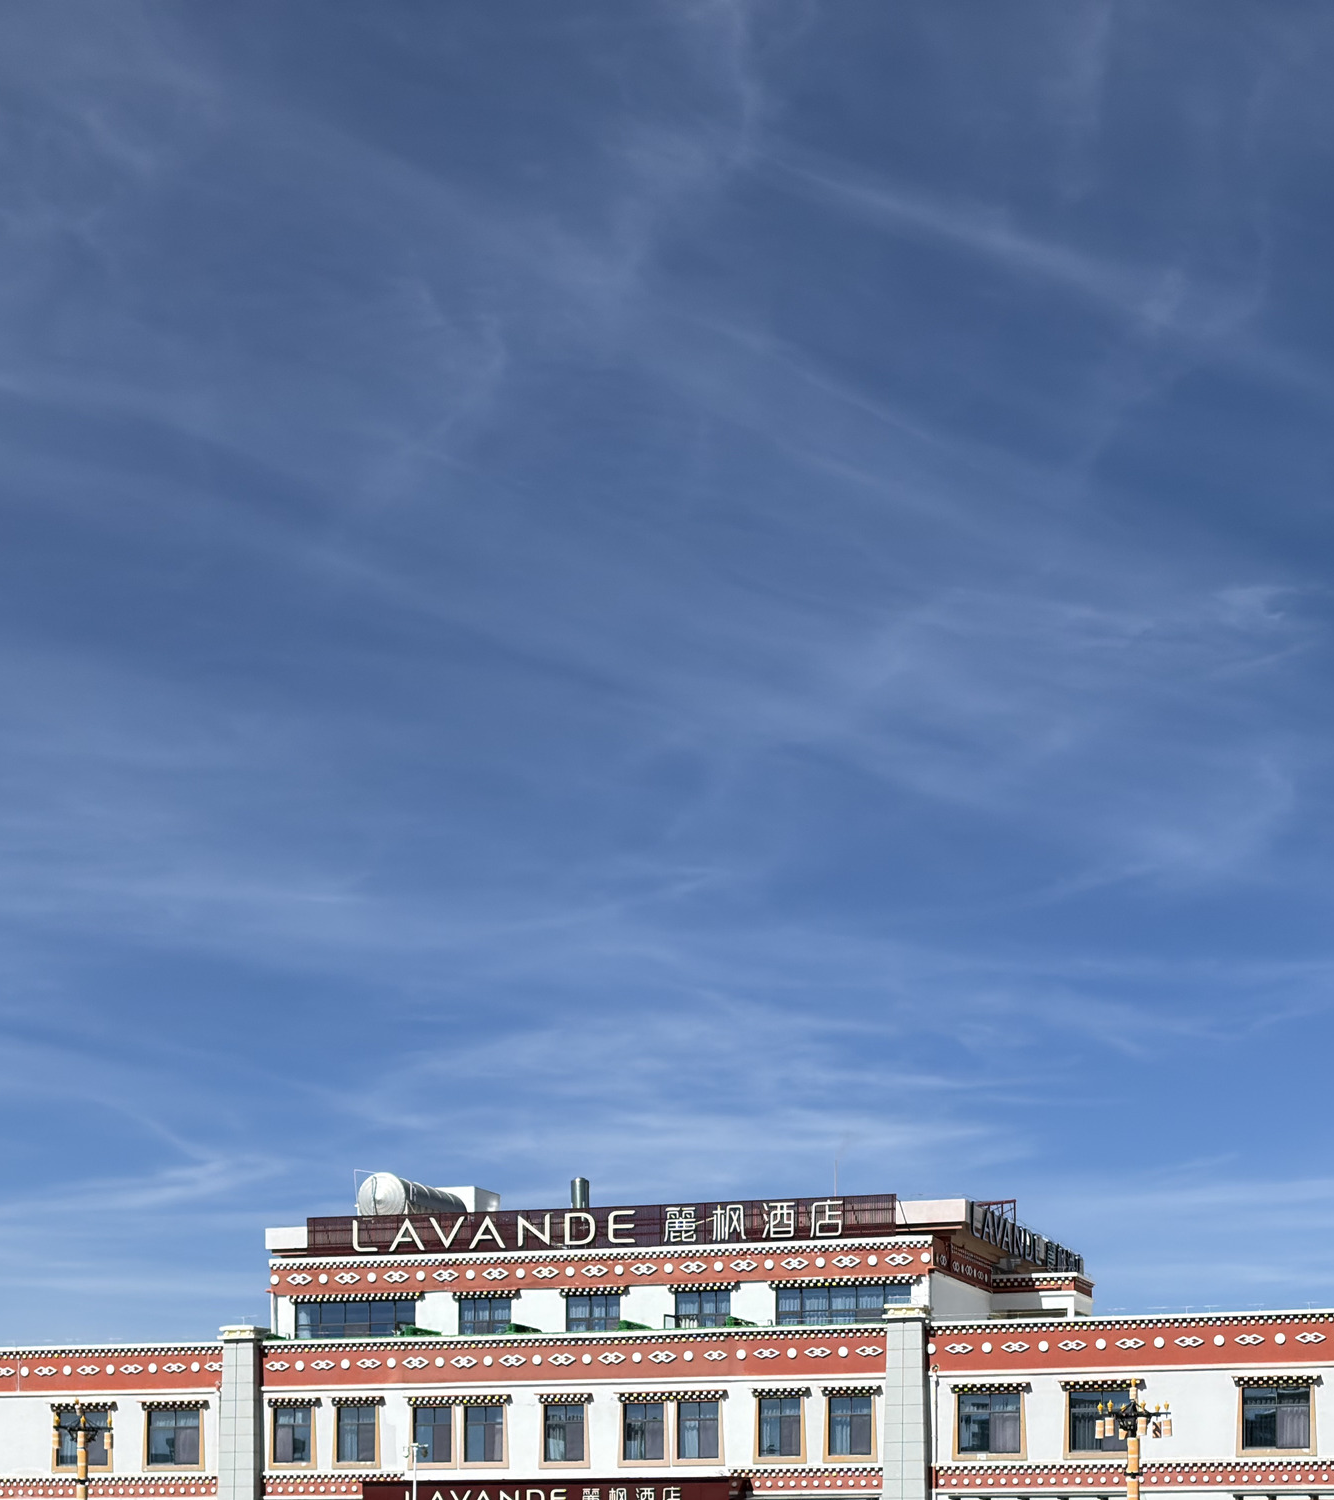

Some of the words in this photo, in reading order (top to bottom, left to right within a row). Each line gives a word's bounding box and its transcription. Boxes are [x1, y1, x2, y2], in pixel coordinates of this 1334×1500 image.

[352, 1209, 636, 1253] LAVANDE
[663, 1199, 844, 1244] 麗枫酒店
